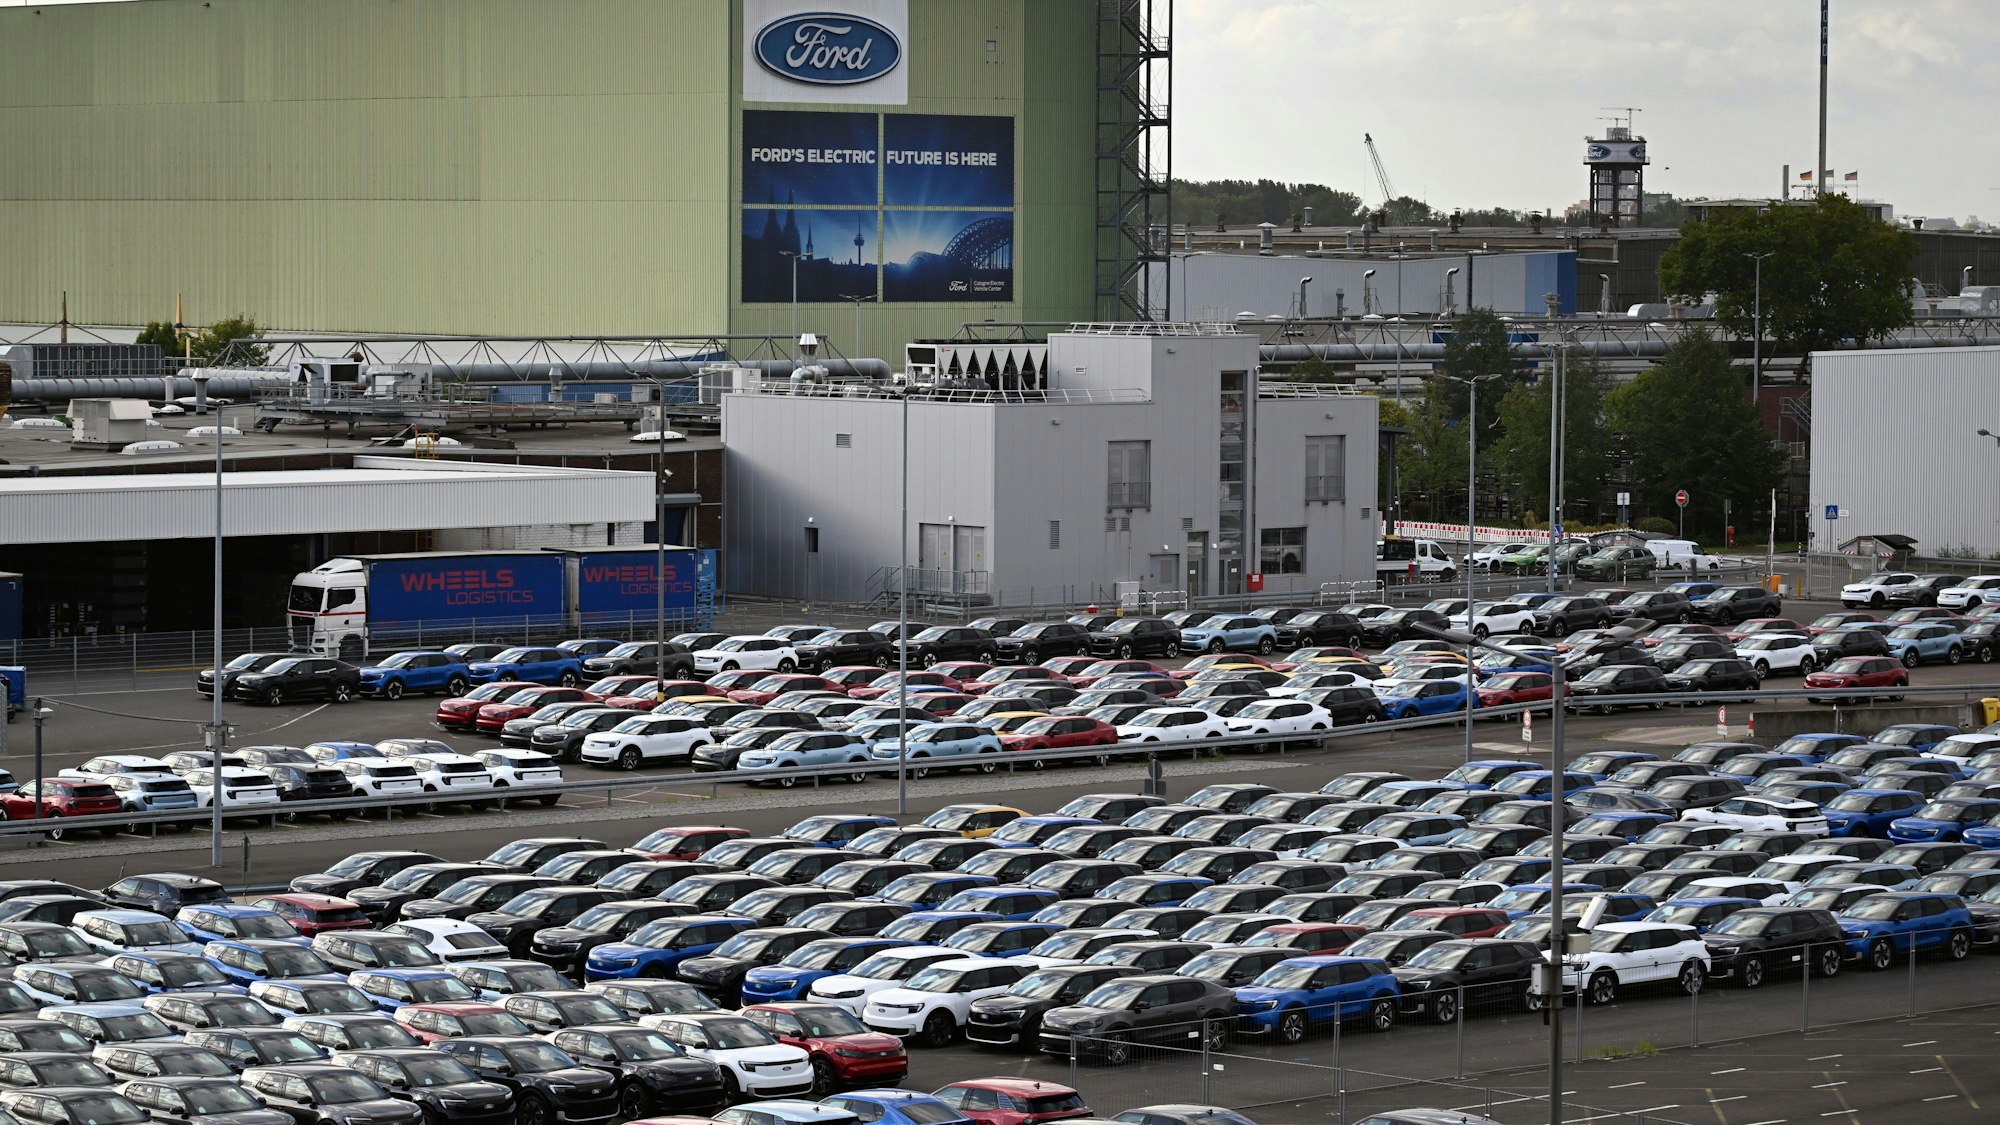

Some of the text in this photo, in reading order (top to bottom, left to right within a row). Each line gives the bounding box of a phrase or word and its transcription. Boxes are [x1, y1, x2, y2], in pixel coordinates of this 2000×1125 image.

[786, 22, 873, 70] Ford
[751, 147, 997, 166] FORD'S ELECTRIC FUTURE IS HERE
[949, 280, 968, 291] Ford
[400, 569, 514, 592] WHEELS
[584, 564, 677, 583] WHEELS
[446, 590, 534, 605] LOGISTICS
[620, 581, 692, 595] LOGISTICS
